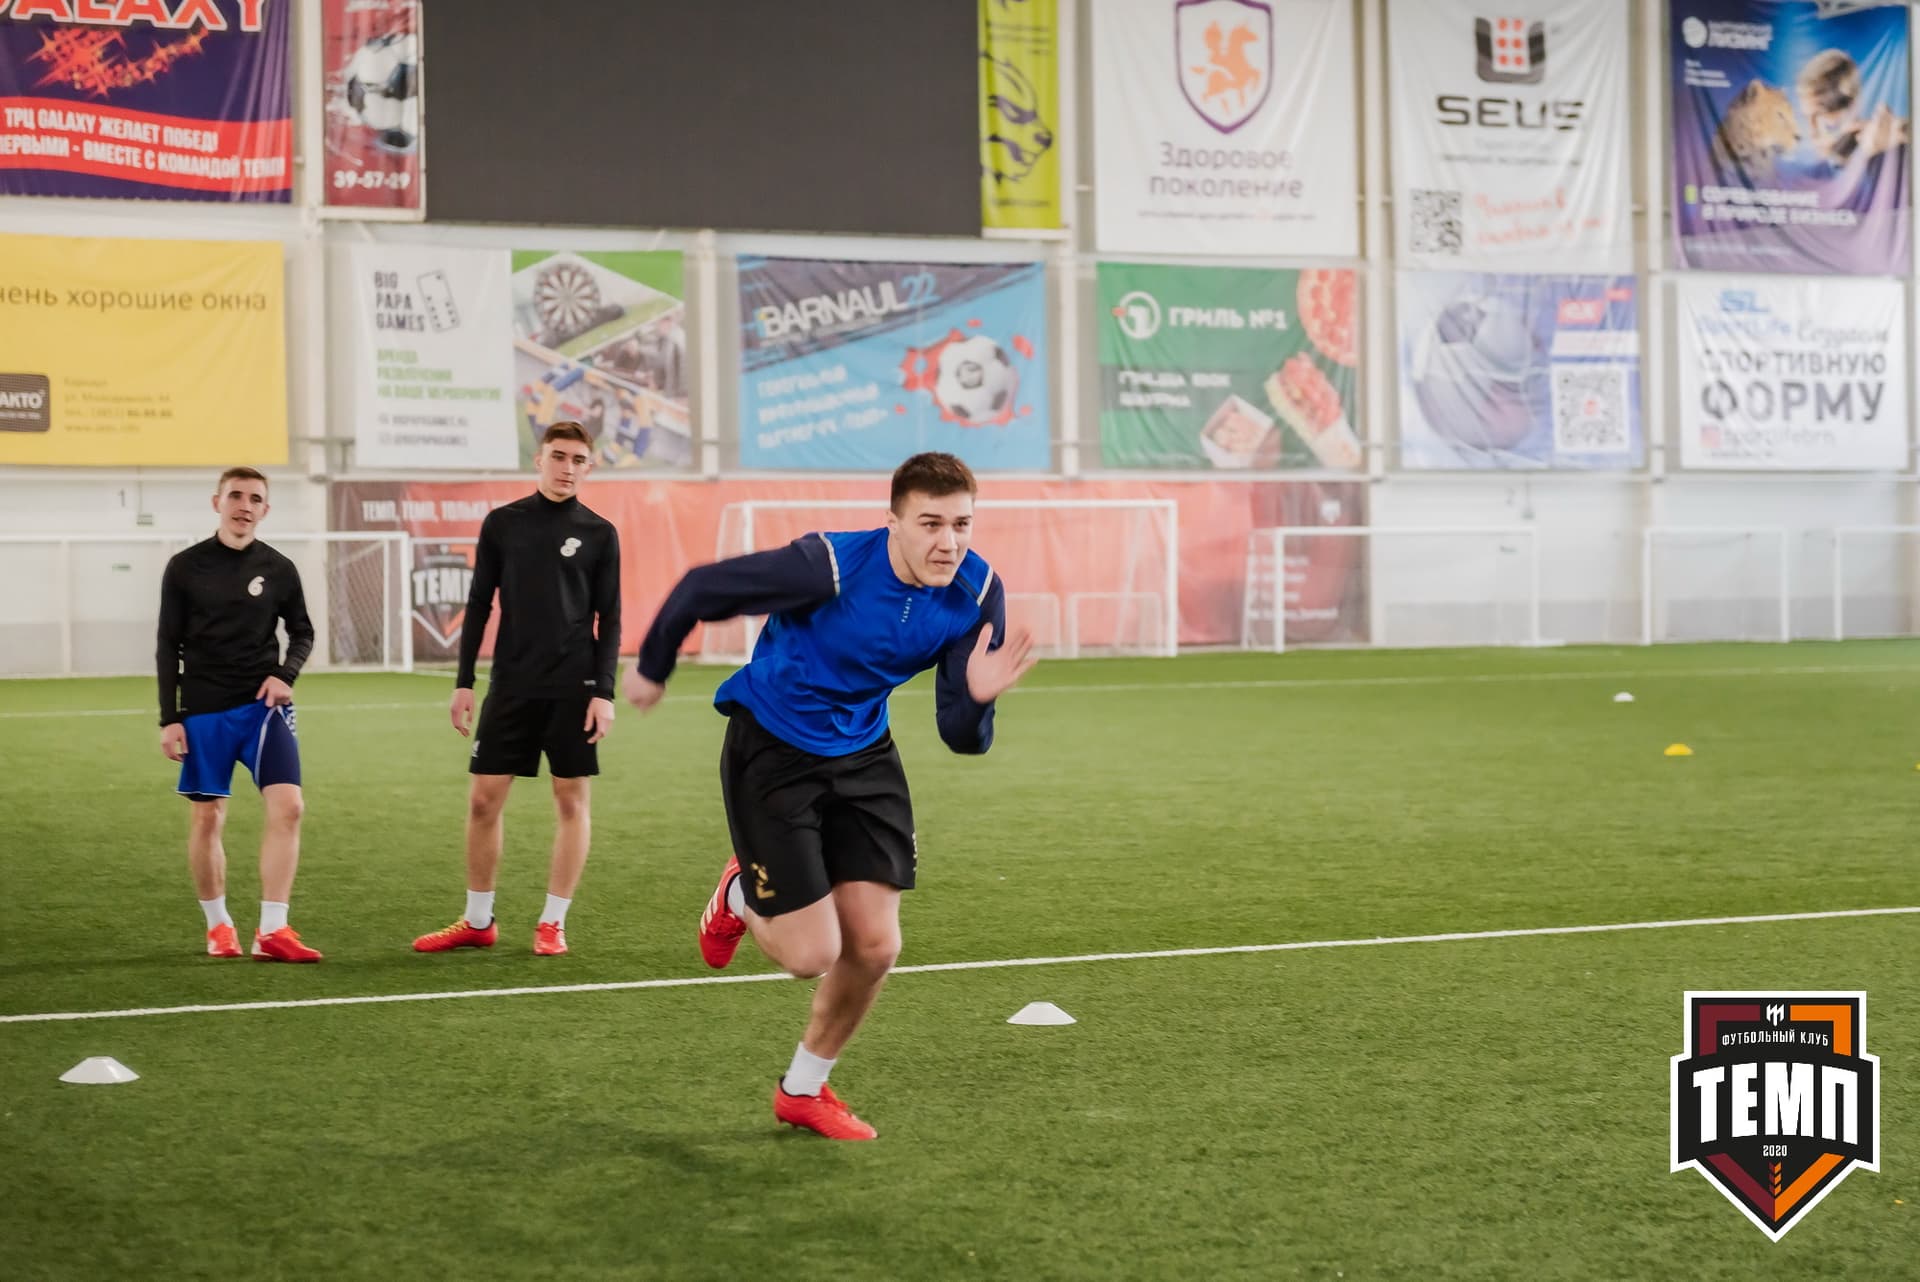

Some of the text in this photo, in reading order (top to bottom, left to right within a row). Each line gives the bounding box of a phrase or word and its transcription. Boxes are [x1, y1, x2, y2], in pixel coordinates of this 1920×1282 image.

[0, 0, 263, 32] ALAXY
[5, 107, 218, 153] ТРЦ GALAXY ЖЕЛАЕТ ПОБЕД!
[83, 140, 142, 169] ВМЕСТЕ
[144, 152, 156, 171] С
[158, 154, 240, 180] КОМАНДОЙ
[1160, 141, 1294, 169] Здоровое
[1150, 176, 1304, 198] поколение
[375, 271, 398, 289] BIG
[66, 289, 194, 313] хорошие
[202, 293, 266, 312] окна
[376, 292, 412, 310] PAPA
[376, 312, 425, 332] GAMES
[1169, 307, 1287, 330] ГРИЛЬ №1
[1702, 380, 1885, 421] ФОРМУ
[561, 538, 582, 557] 8
[248, 576, 265, 596] 6
